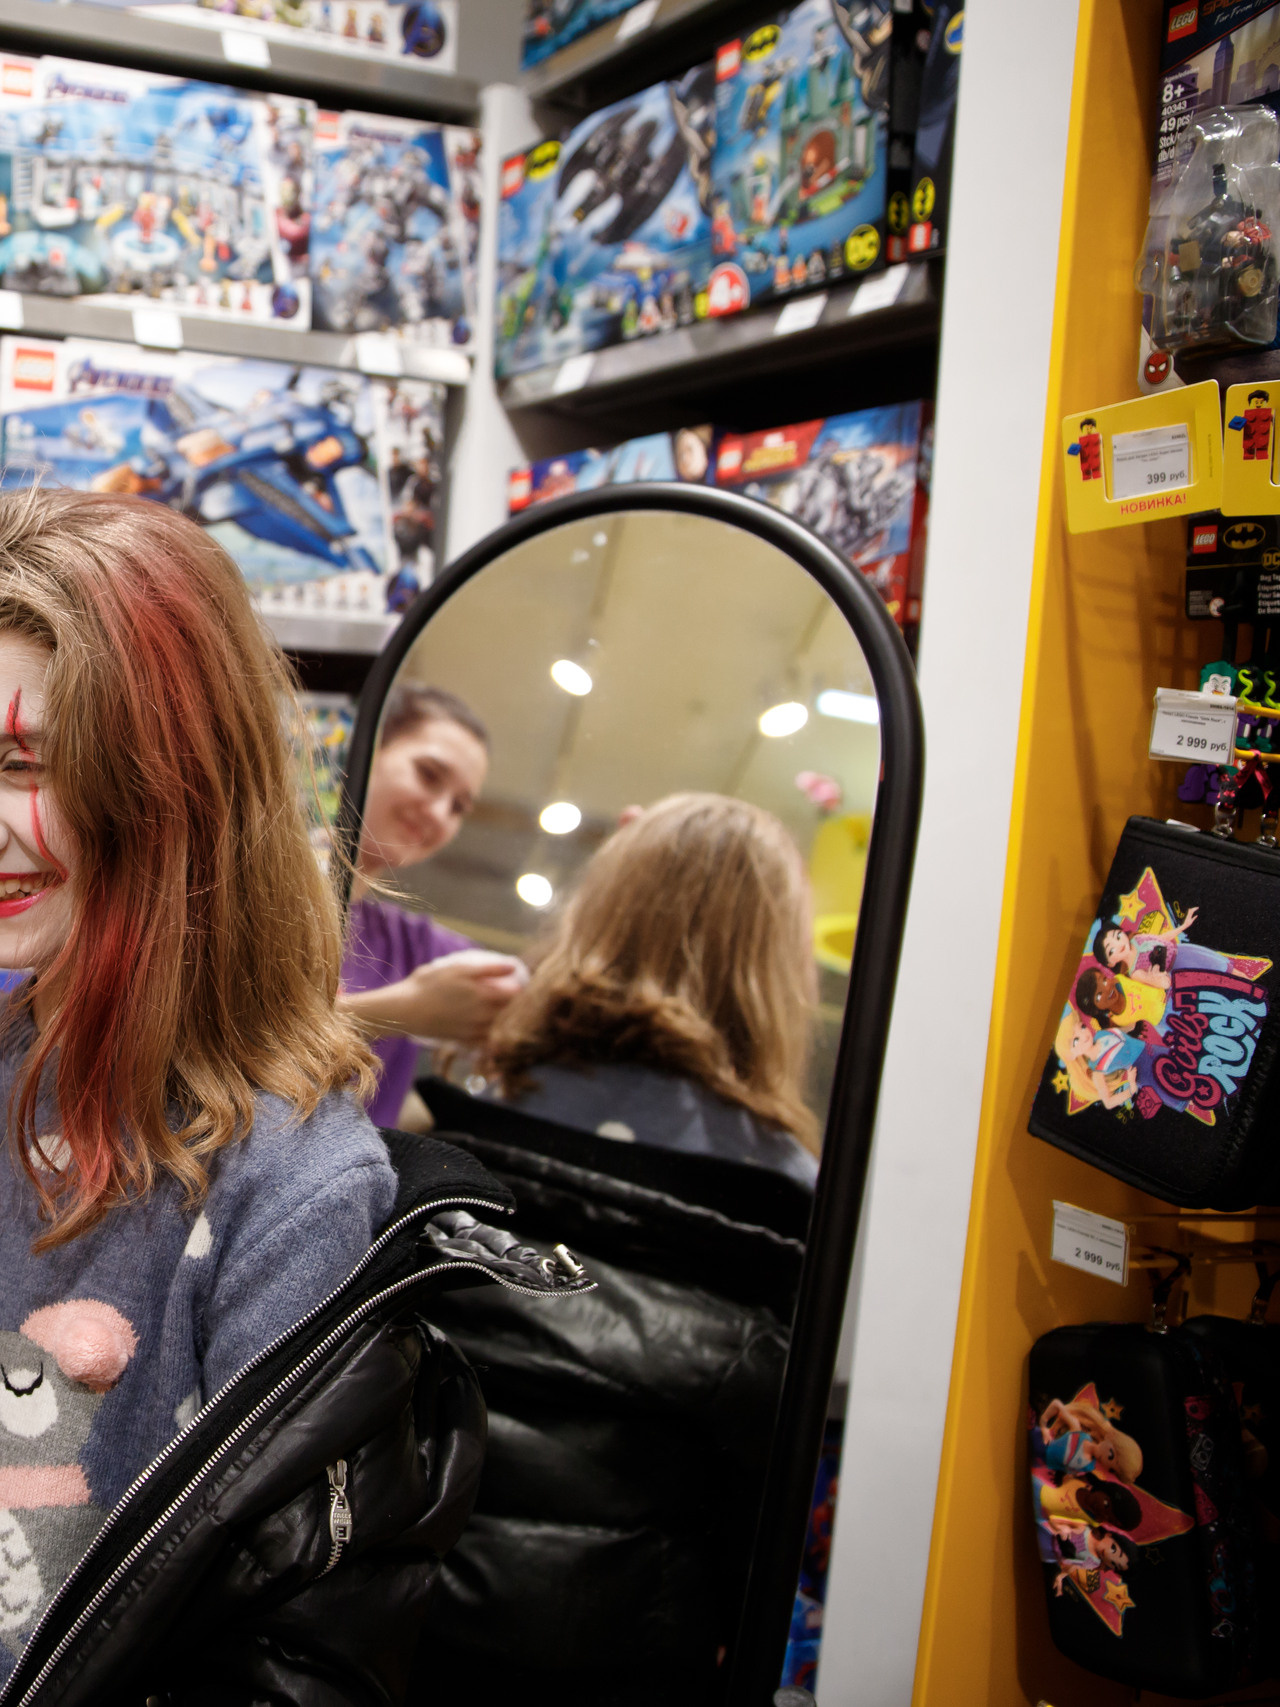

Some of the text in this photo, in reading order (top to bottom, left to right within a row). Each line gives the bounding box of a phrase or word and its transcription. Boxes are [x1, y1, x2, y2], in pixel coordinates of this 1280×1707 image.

[1170, 8, 1197, 32] LEGO
[1162, 83, 1185, 103] 8+
[1161, 100, 1187, 116] 40343
[1160, 118, 1176, 133] 49
[1147, 470, 1187, 485] 399 руб.
[1120, 493, 1187, 515] НОВИНКА!
[1195, 533, 1216, 546] LEGO
[1176, 734, 1228, 752] 2 999 руб.
[1074, 1247, 1082, 1258] 2
[1084, 1250, 1103, 1265] 999
